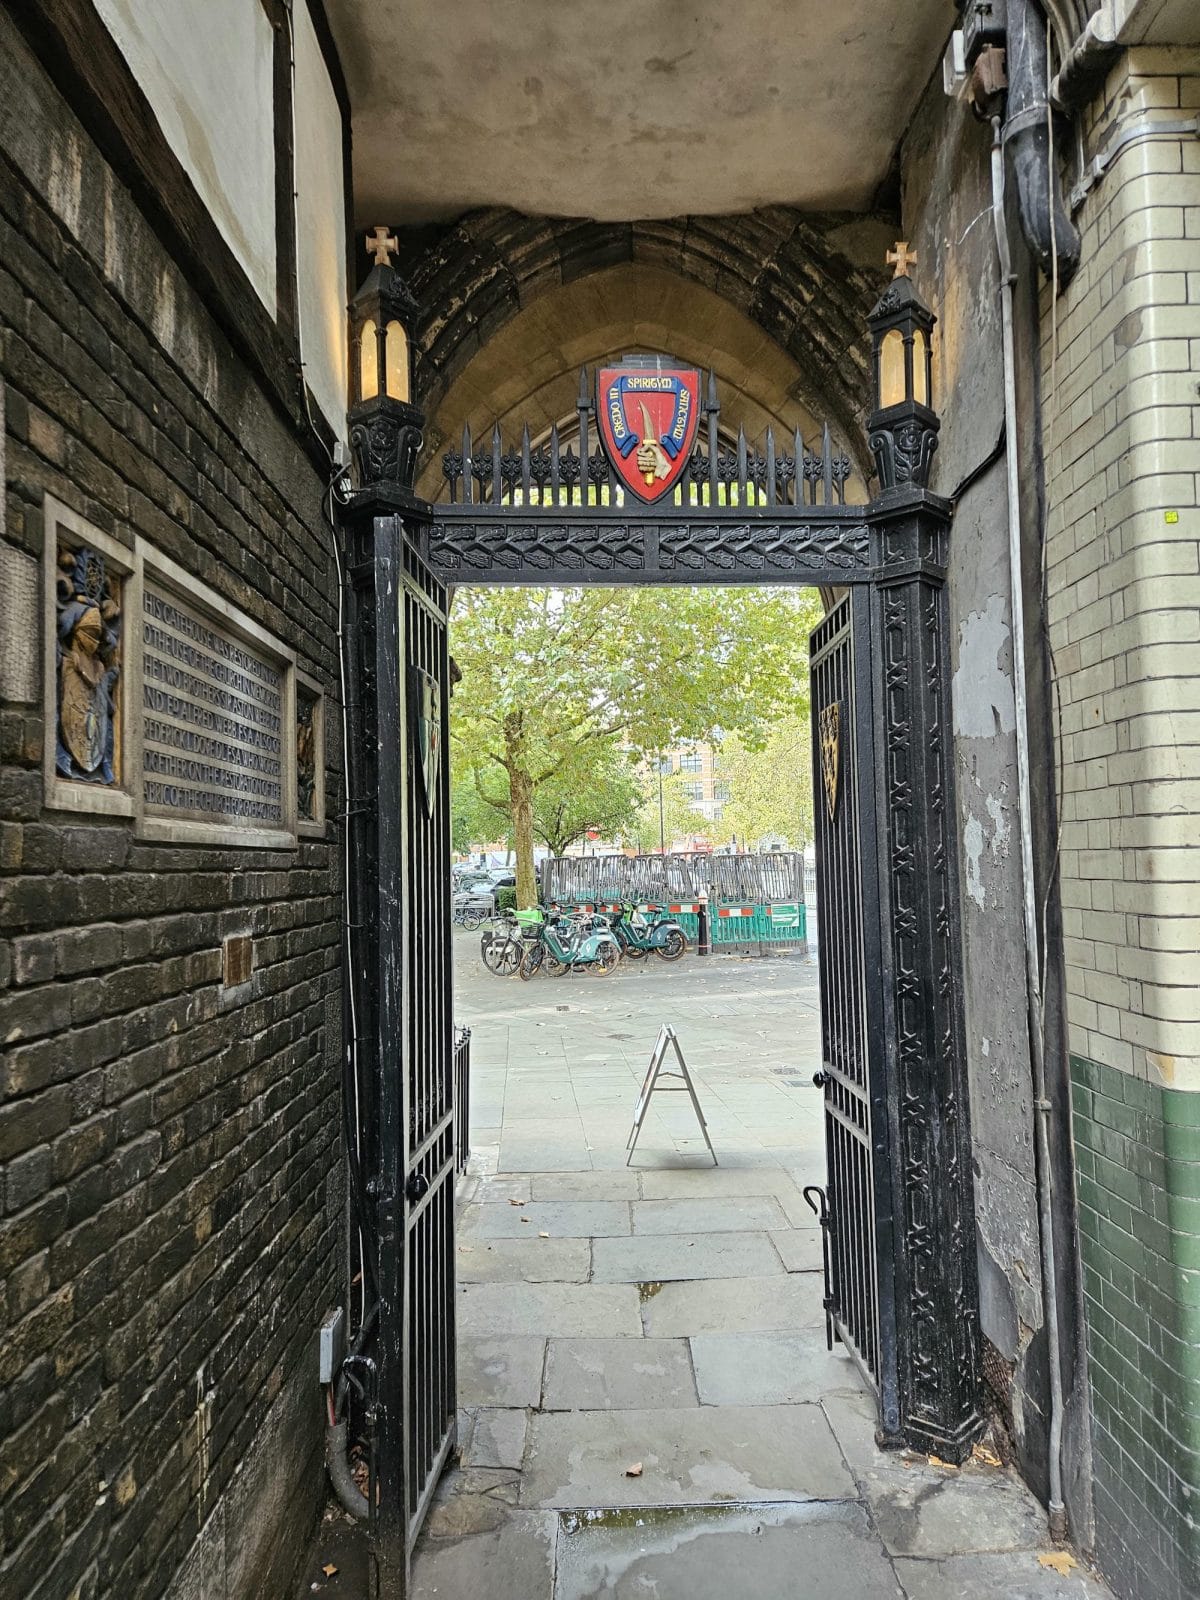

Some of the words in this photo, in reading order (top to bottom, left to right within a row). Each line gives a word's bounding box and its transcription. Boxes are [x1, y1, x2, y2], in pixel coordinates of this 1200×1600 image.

[144, 592, 161, 621] HIS
[143, 622, 151, 646] O
[151, 626, 171, 656] THE
[171, 637, 188, 664] USE
[214, 660, 242, 691] CHURCH
[144, 654, 159, 681] HE
[159, 661, 180, 690] TWO
[231, 695, 254, 722] ASTON
[143, 717, 186, 750] REDERICK
[181, 700, 213, 731] ALFRED
[214, 713, 236, 739] WEBB
[255, 729, 272, 751] ALSO
[143, 748, 187, 779] OGETHER
[188, 760, 202, 782] ON
[202, 763, 219, 786] THE
[219, 768, 262, 796] RESTORATION
[143, 780, 170, 805] ABRIC
